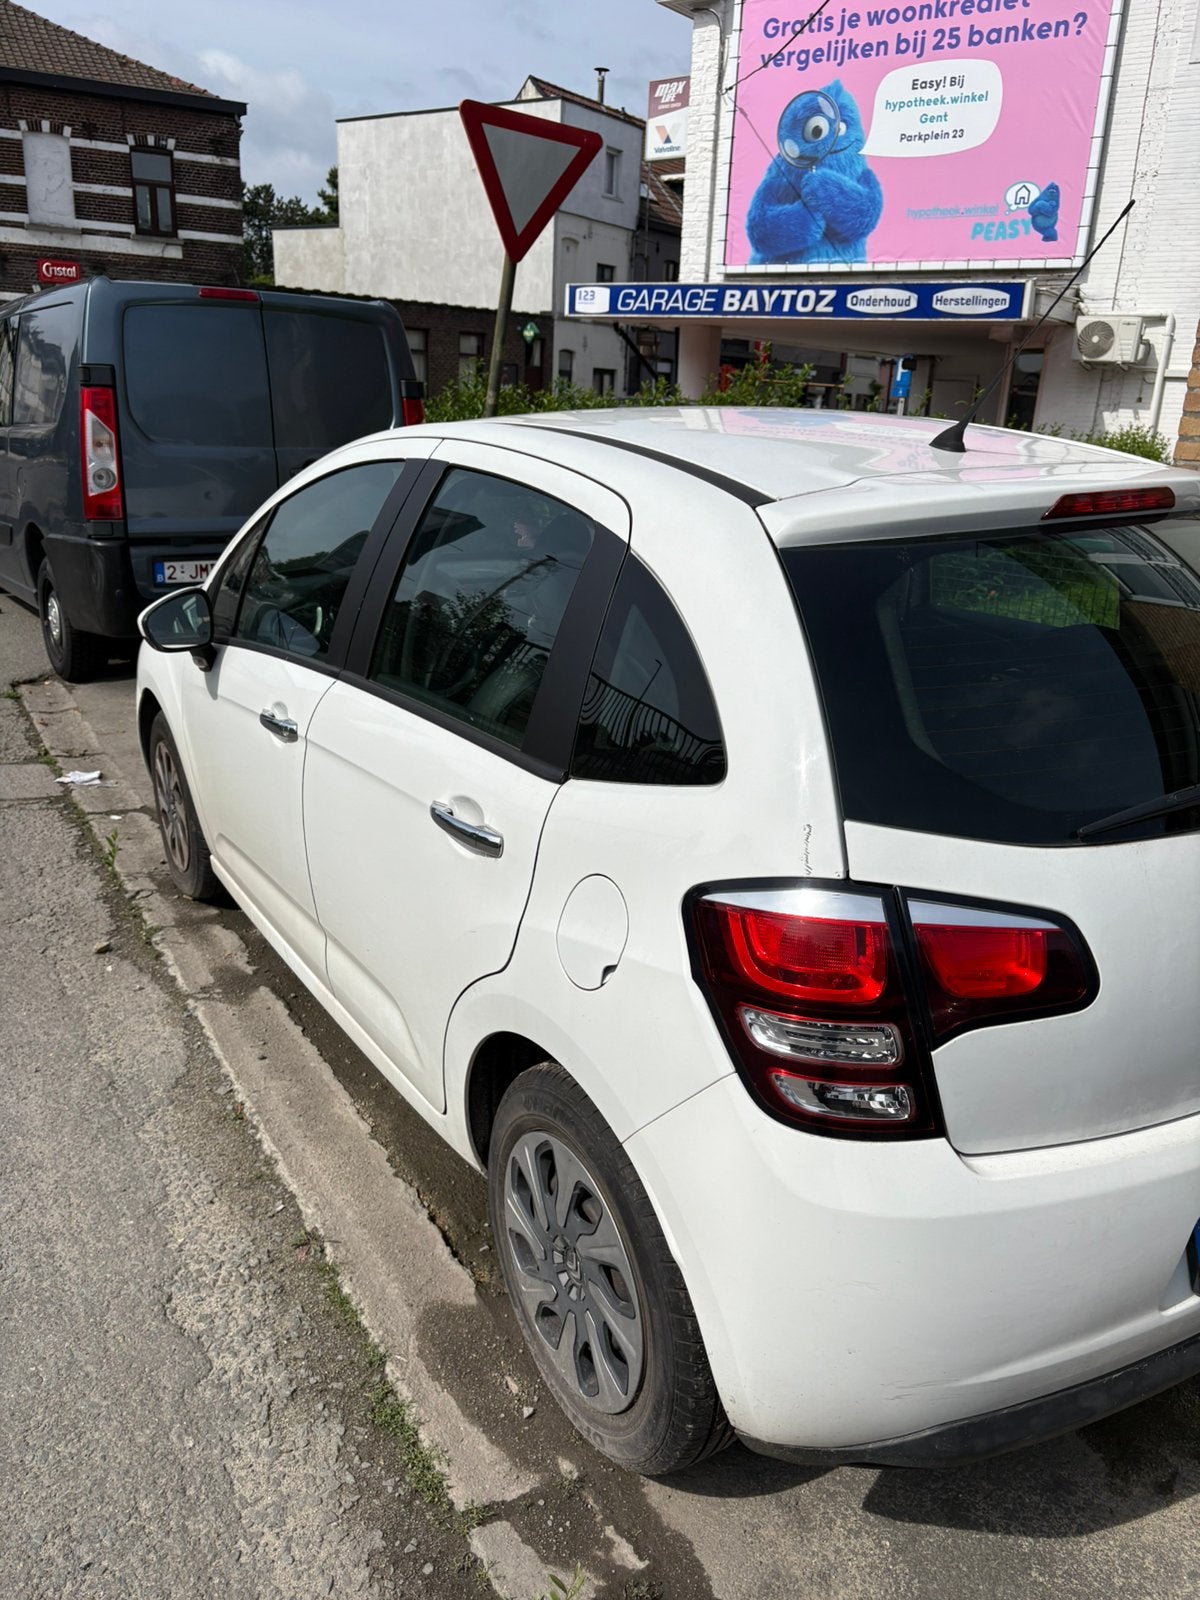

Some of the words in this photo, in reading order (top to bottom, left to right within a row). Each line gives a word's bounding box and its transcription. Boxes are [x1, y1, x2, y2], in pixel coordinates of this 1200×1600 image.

[763, 11, 834, 39] Gratis
[836, 8, 861, 36] je
[761, 38, 889, 71] vergelijken
[895, 29, 927, 59] bij
[932, 26, 962, 51] 25
[967, 11, 1088, 47] banken?
[911, 75, 948, 91] Easy!
[949, 75, 966, 89] Bij
[885, 90, 990, 112] hypotheek.winkel
[919, 111, 949, 124] Gent
[899, 129, 950, 143] Parkplein
[951, 128, 965, 139] 23
[970, 218, 1031, 241] PEASY
[578, 290, 596, 301] 123
[617, 288, 719, 312] GARAGE
[722, 289, 837, 313] BAYTOZ
[850, 295, 911, 307] Onderhoud
[935, 295, 1007, 308] Herstellingen
